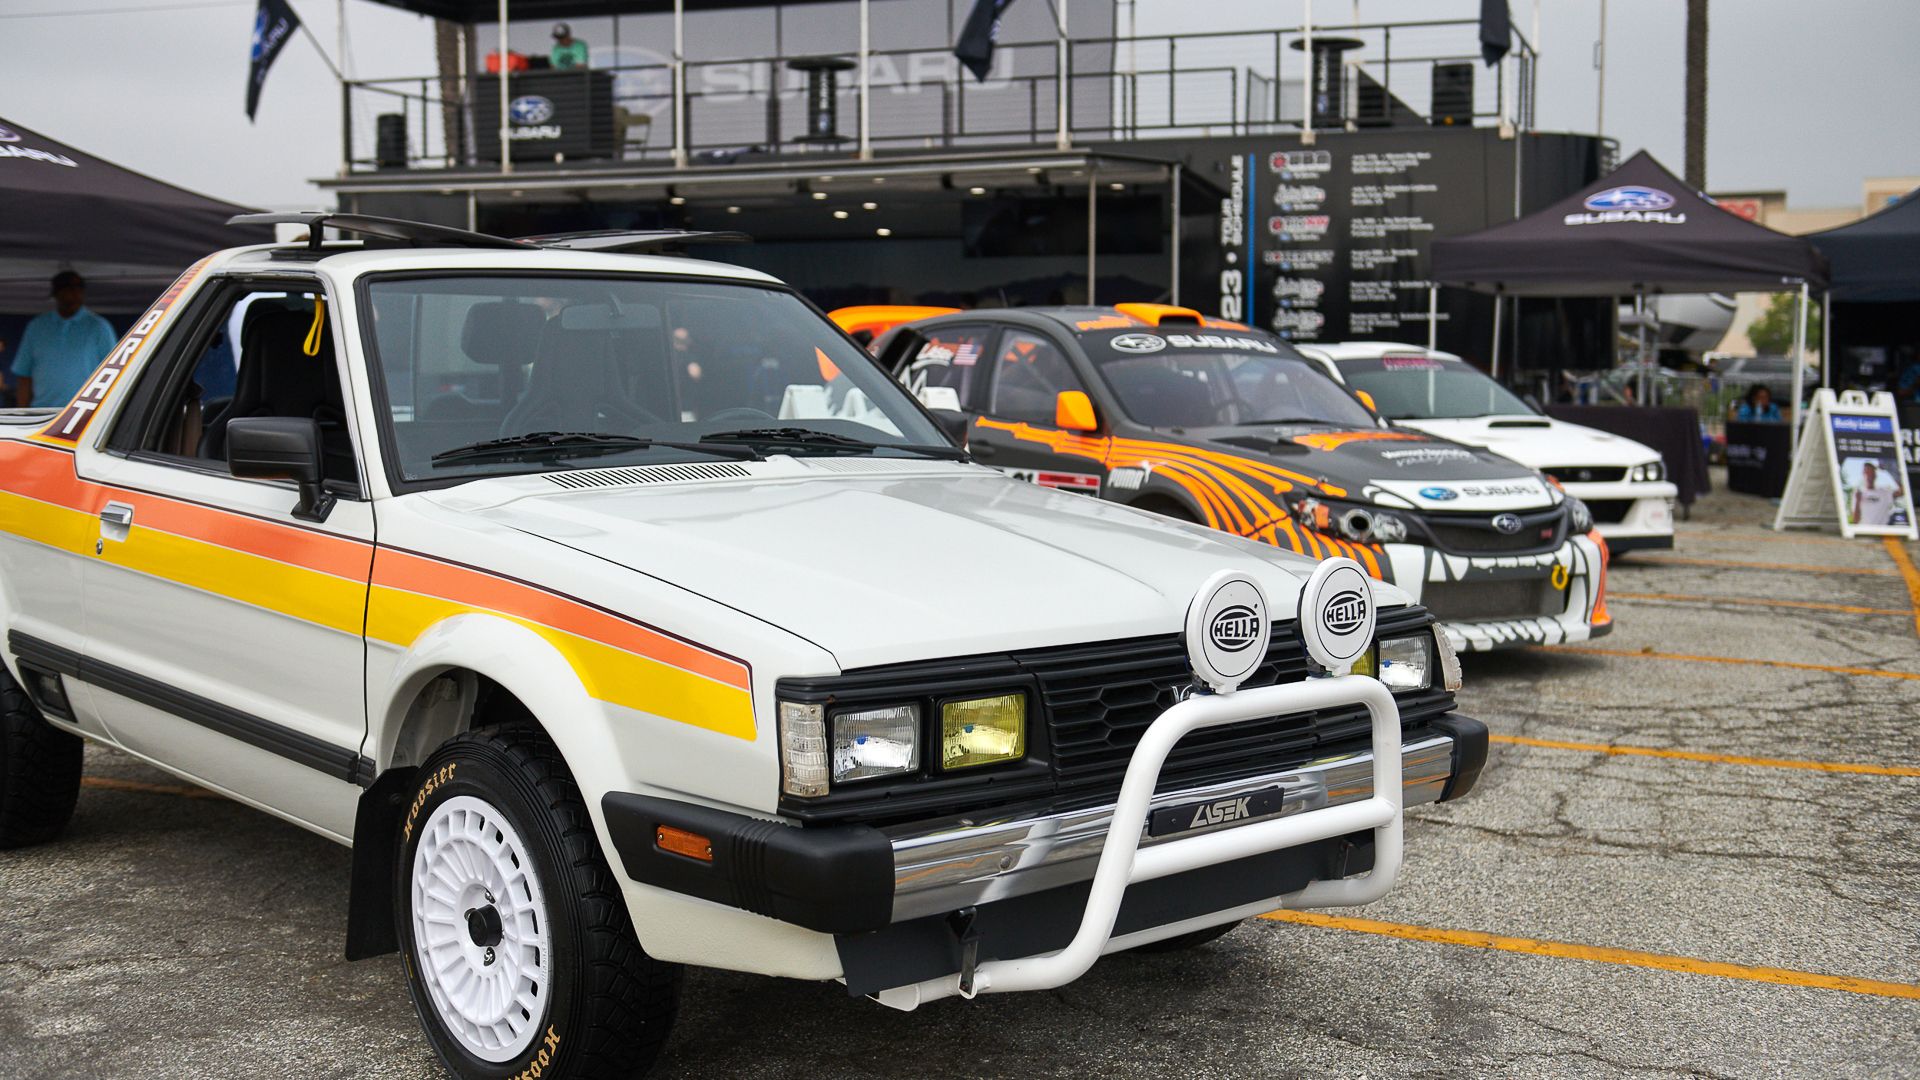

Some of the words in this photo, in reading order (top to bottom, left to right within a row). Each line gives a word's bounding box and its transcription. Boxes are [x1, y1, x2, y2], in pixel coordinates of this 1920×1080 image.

[700, 48, 1014, 102] SUARU
[501, 125, 561, 139] UBARU
[1221, 198, 1232, 247] TOUR
[1564, 211, 1686, 225] SUBARU
[1166, 334, 1278, 353] SUBARU
[62, 309, 164, 434] BRAT
[1463, 485, 1541, 497] SUBARU
[1326, 599, 1367, 623] HELLA
[1214, 617, 1260, 638] HELLA
[404, 762, 457, 842] Hoosier
[1189, 796, 1252, 828] LASEK
[507, 1023, 560, 1080] Hoos
